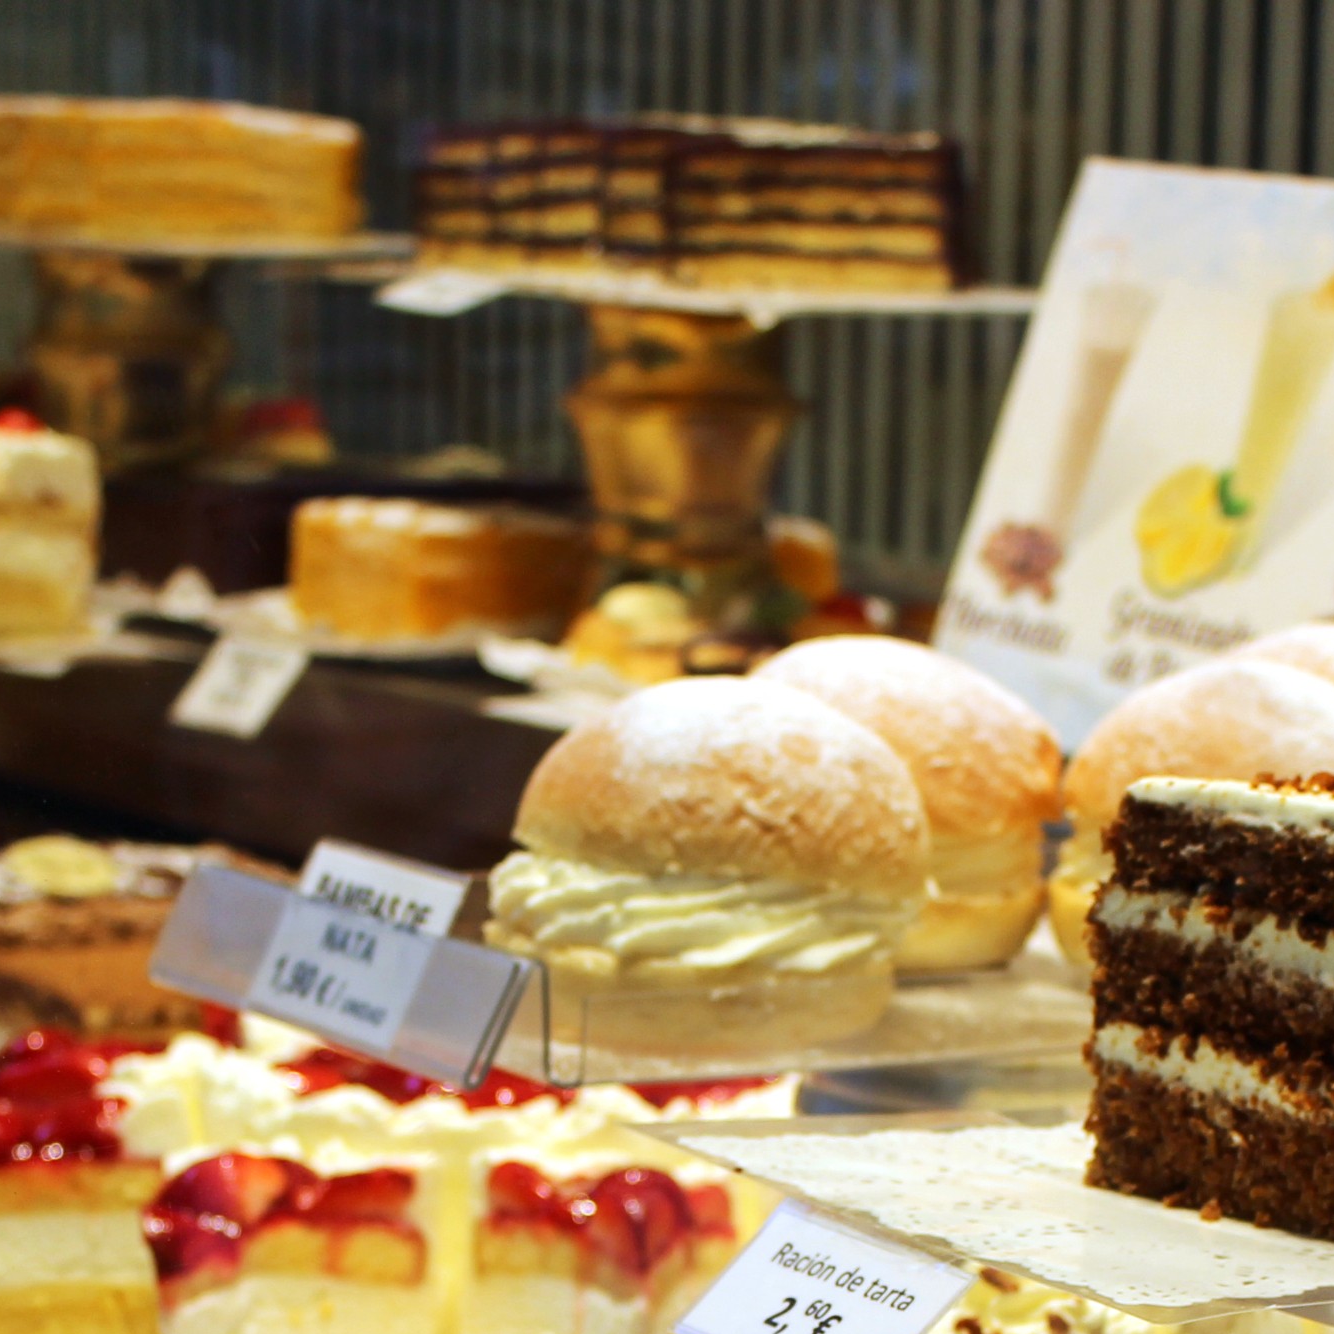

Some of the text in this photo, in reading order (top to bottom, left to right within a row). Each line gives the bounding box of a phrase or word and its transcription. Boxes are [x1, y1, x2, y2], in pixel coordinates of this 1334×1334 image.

[771, 1242, 915, 1312] Ración de tarta
